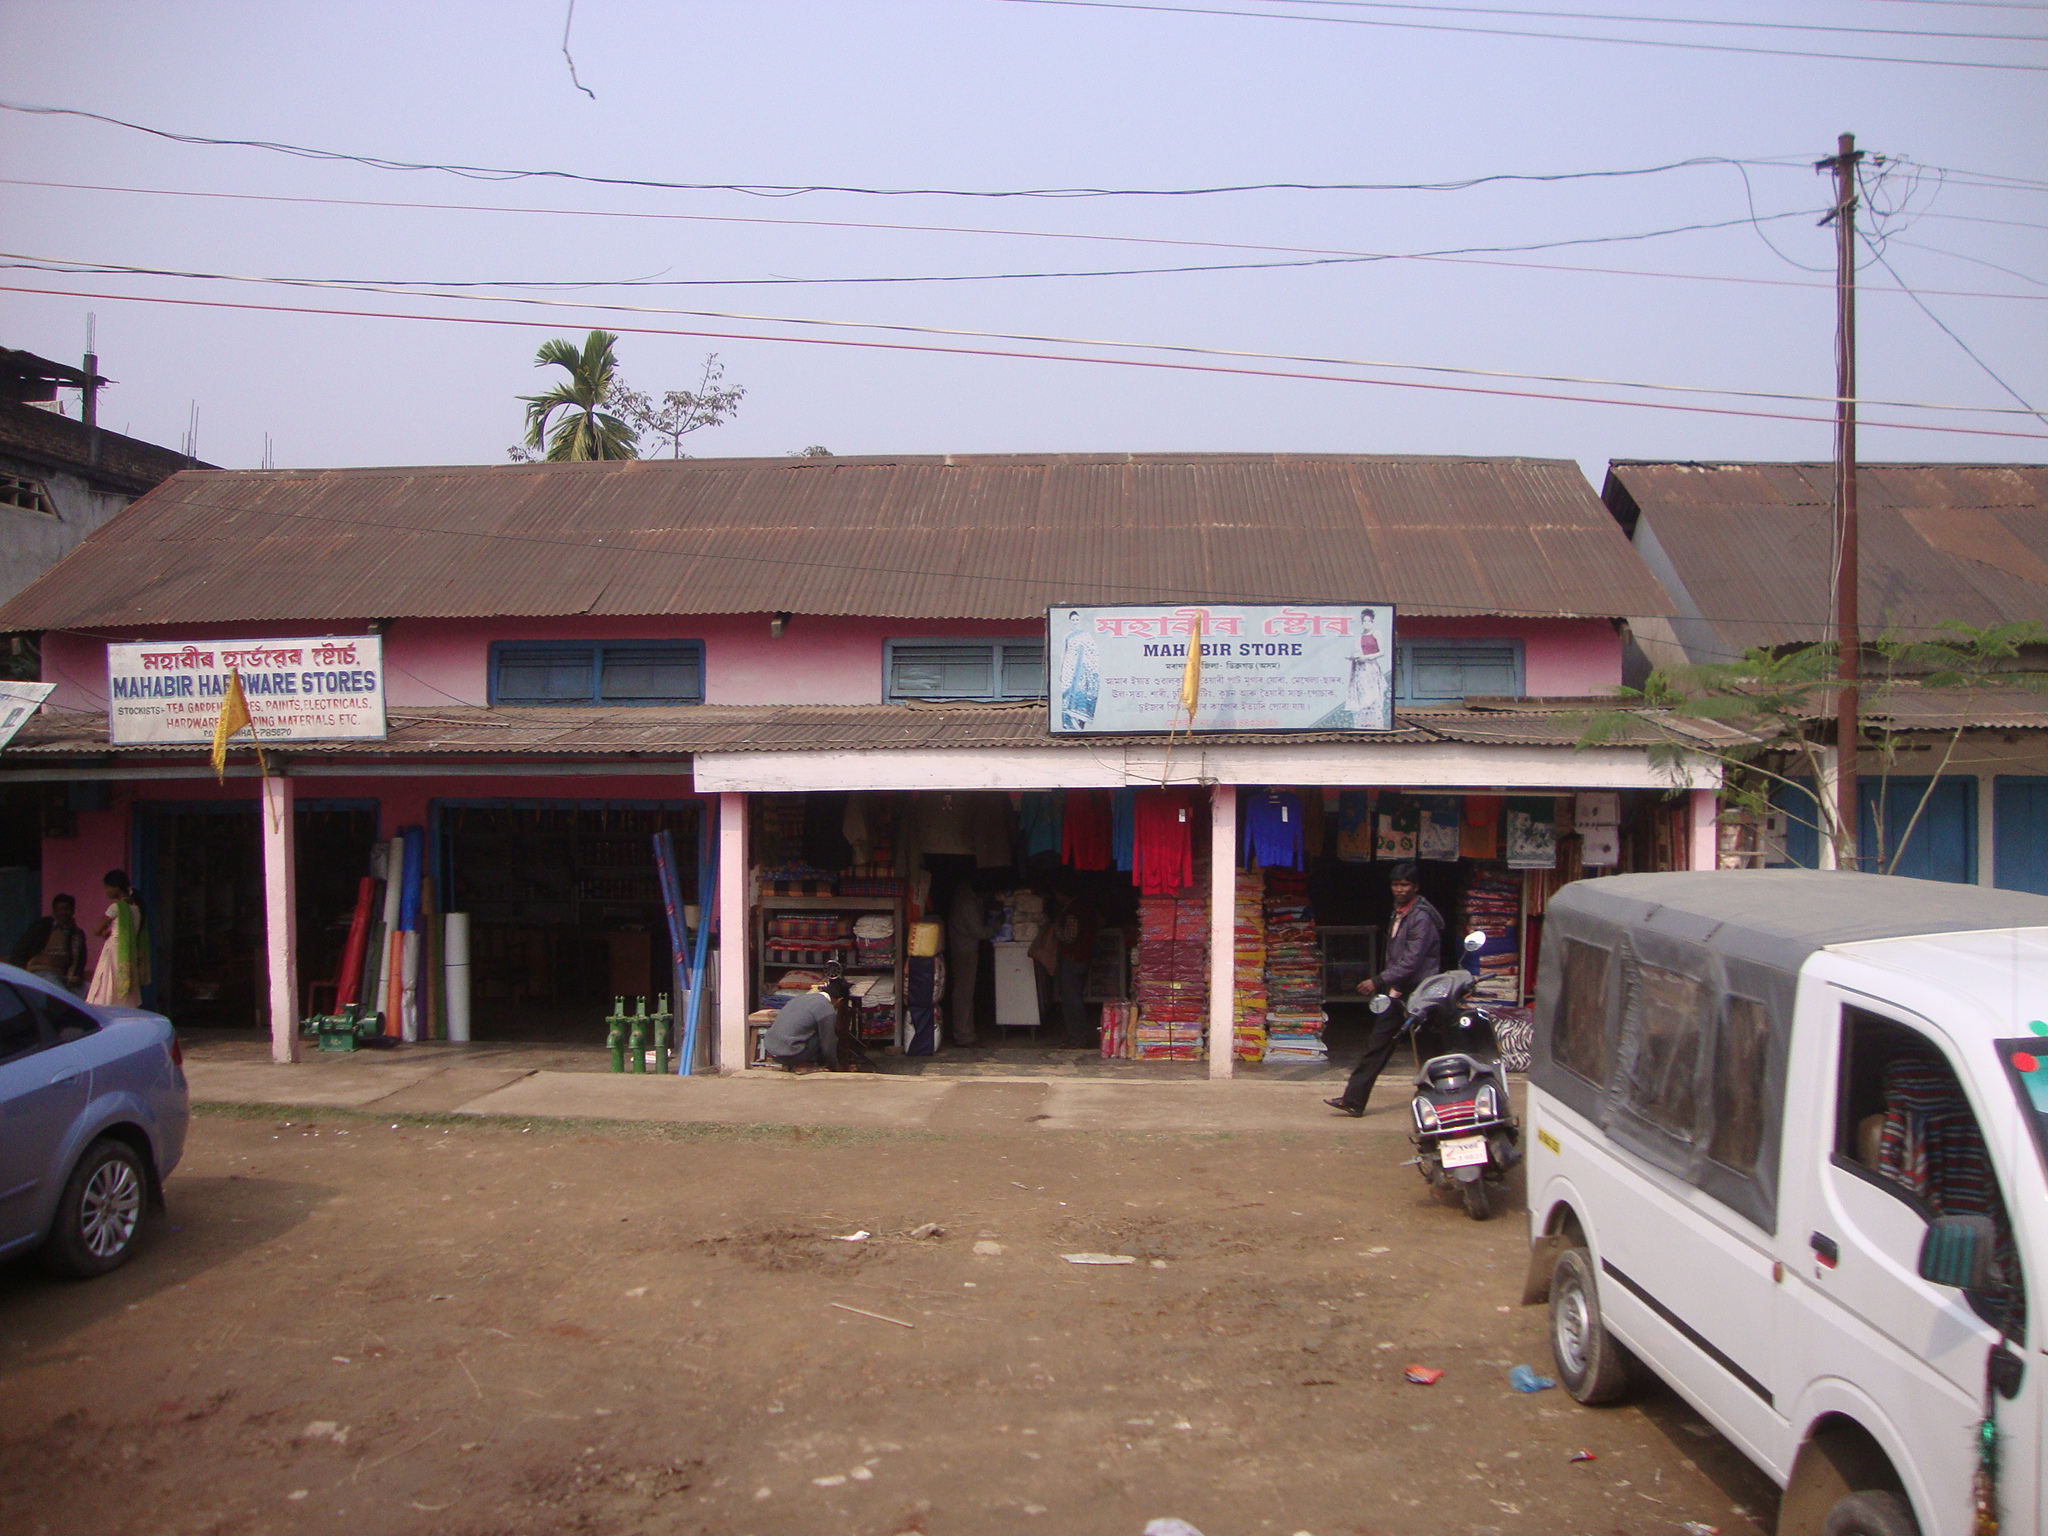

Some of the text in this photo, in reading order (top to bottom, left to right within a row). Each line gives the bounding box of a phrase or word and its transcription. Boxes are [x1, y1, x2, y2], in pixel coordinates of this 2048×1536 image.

[1144, 643, 1302, 657] MAHBIR STORE
[113, 670, 376, 698] MAHABIR HARDWARE STORES
[166, 703, 184, 714] TEA
[188, 702, 222, 714] GARDEN
[278, 714, 335, 727] MATERIALS
[340, 713, 361, 726] ETC.
